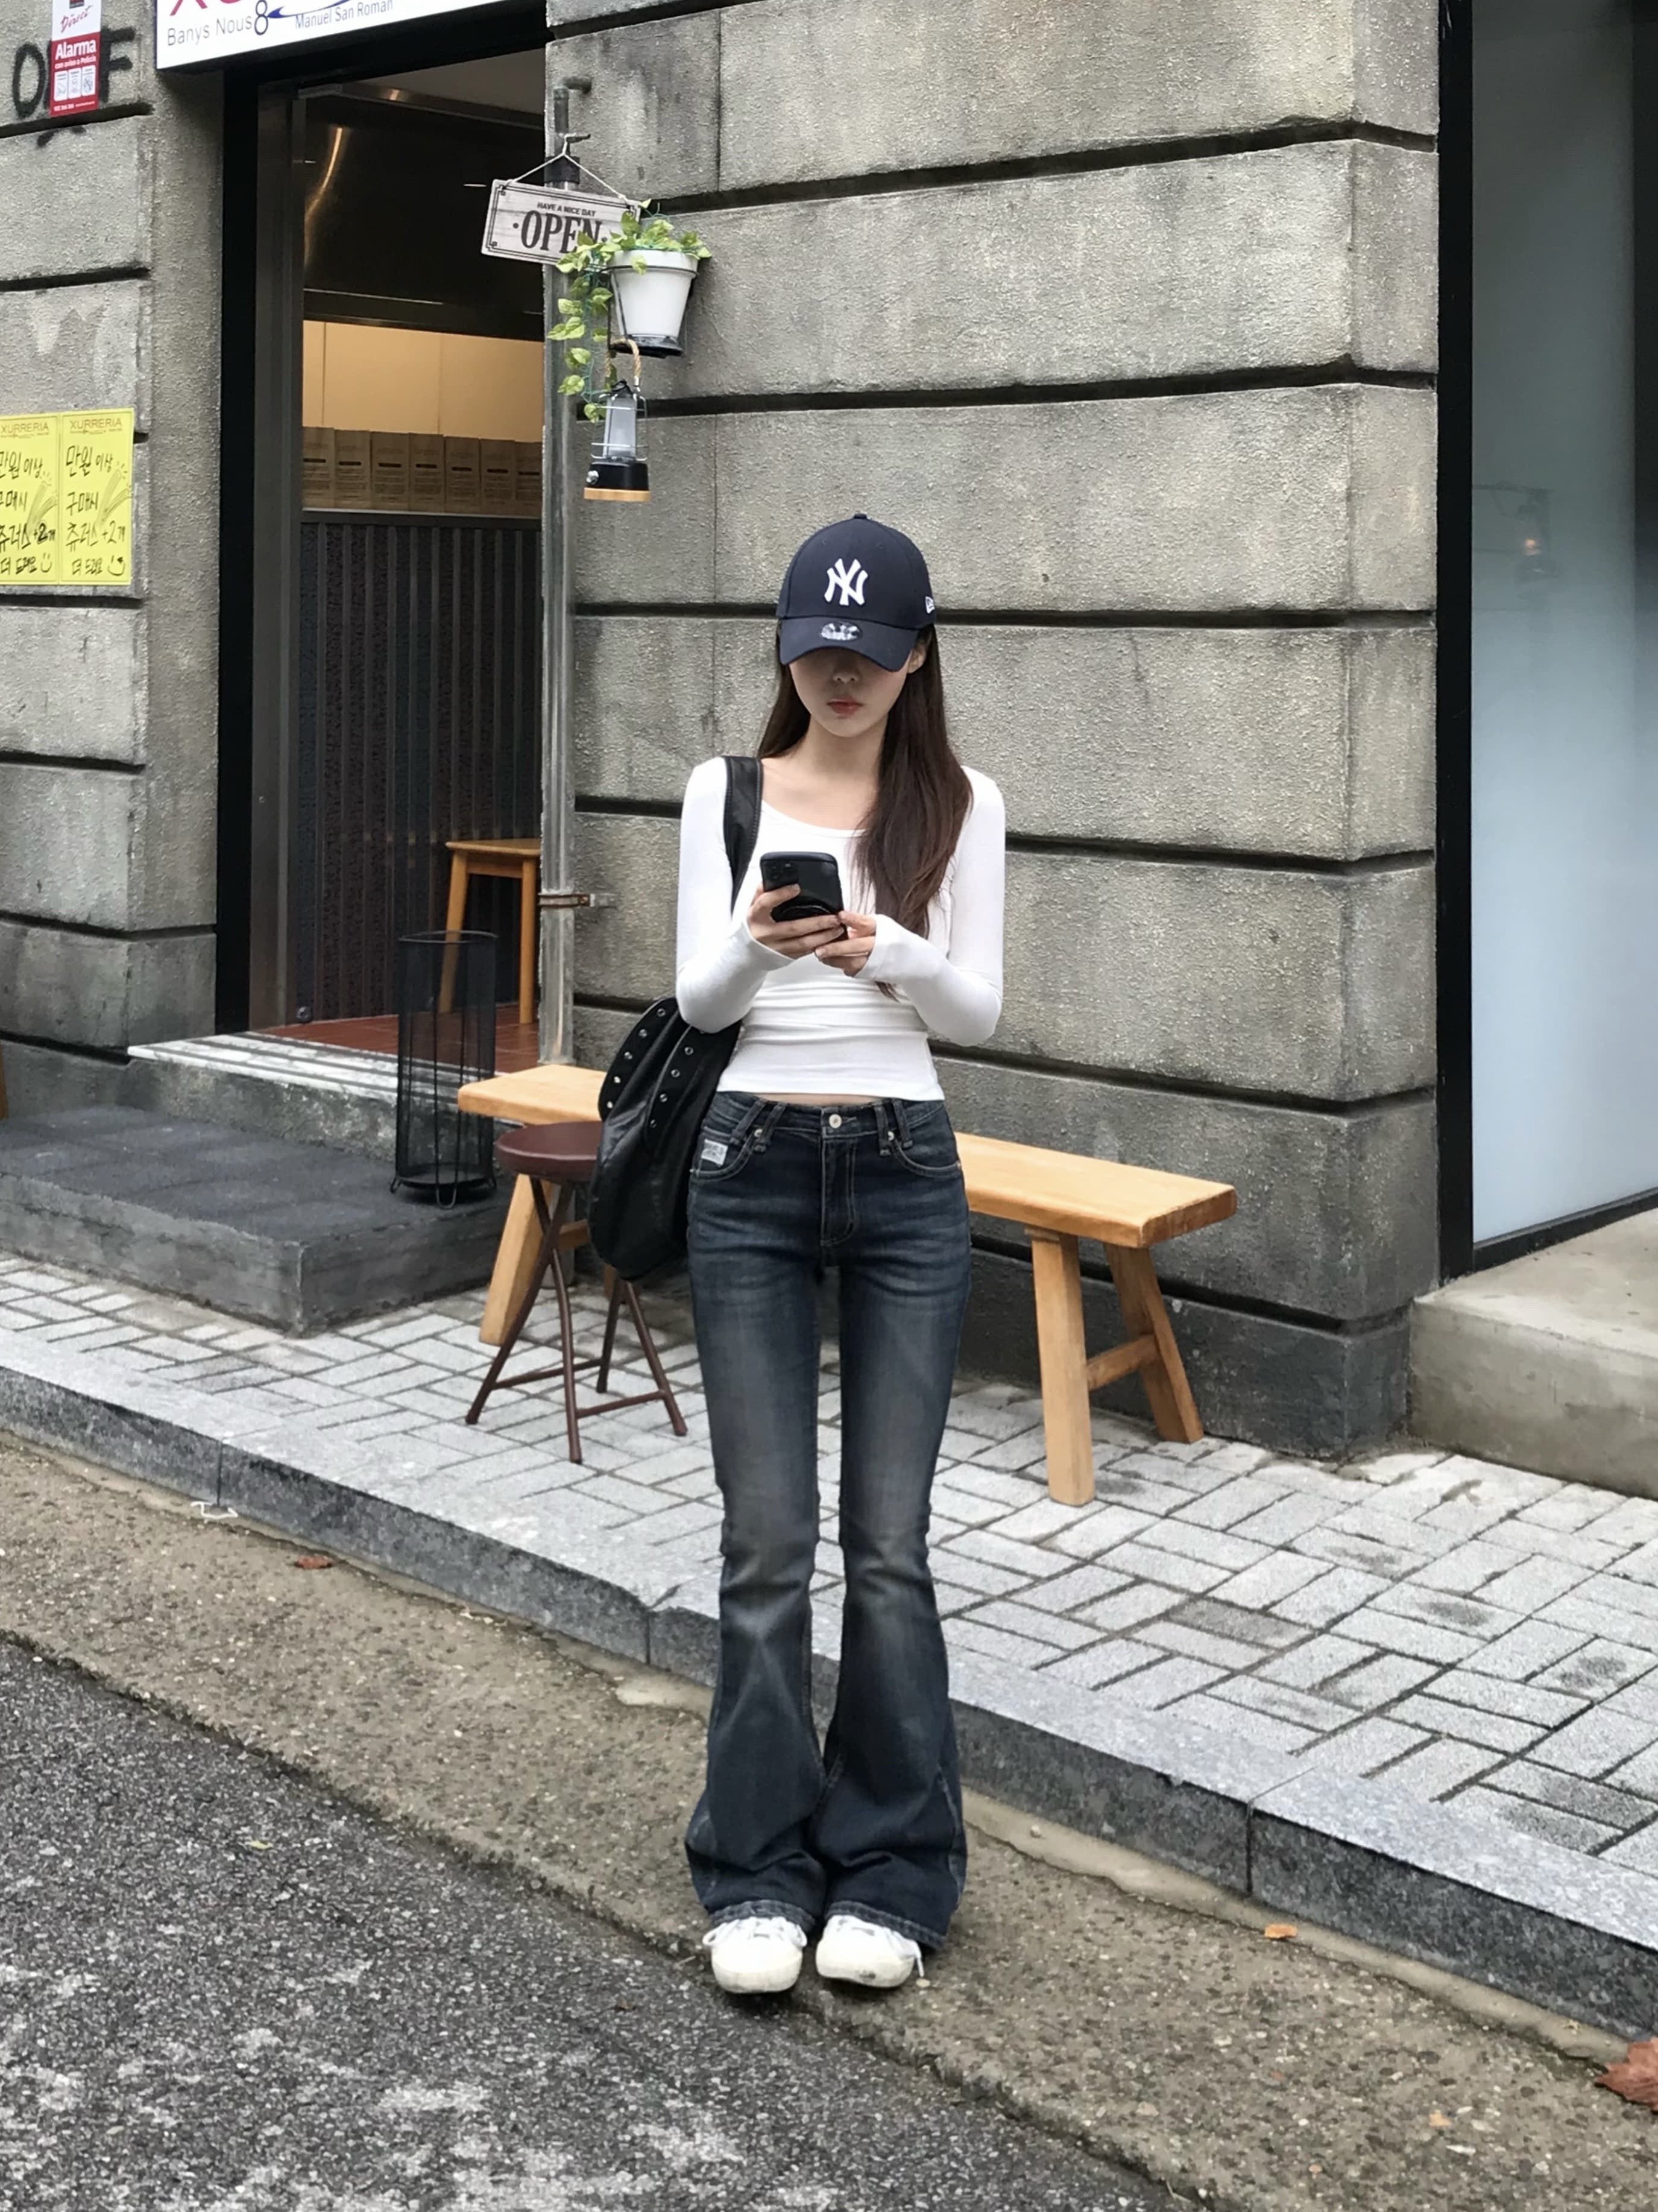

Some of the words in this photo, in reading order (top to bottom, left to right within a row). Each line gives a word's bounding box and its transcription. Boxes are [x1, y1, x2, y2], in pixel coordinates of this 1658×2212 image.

[168, 24, 210, 46] Banys
[216, 15, 253, 36] Nous
[254, 0, 268, 36] 8
[295, 10, 332, 29] Manuel
[335, 6, 354, 22] San
[55, 39, 96, 60] Alarma
[537, 201, 556, 211] HAVE
[564, 206, 581, 215] NICE
[521, 210, 602, 253] OPEN
[1, 422, 49, 434] XURRERIA
[69, 417, 122, 429] XURRERIA
[23, 458, 43, 478] 이상
[66, 445, 93, 478] 만원
[95, 453, 113, 473] 이상
[824, 558, 869, 606] NY
